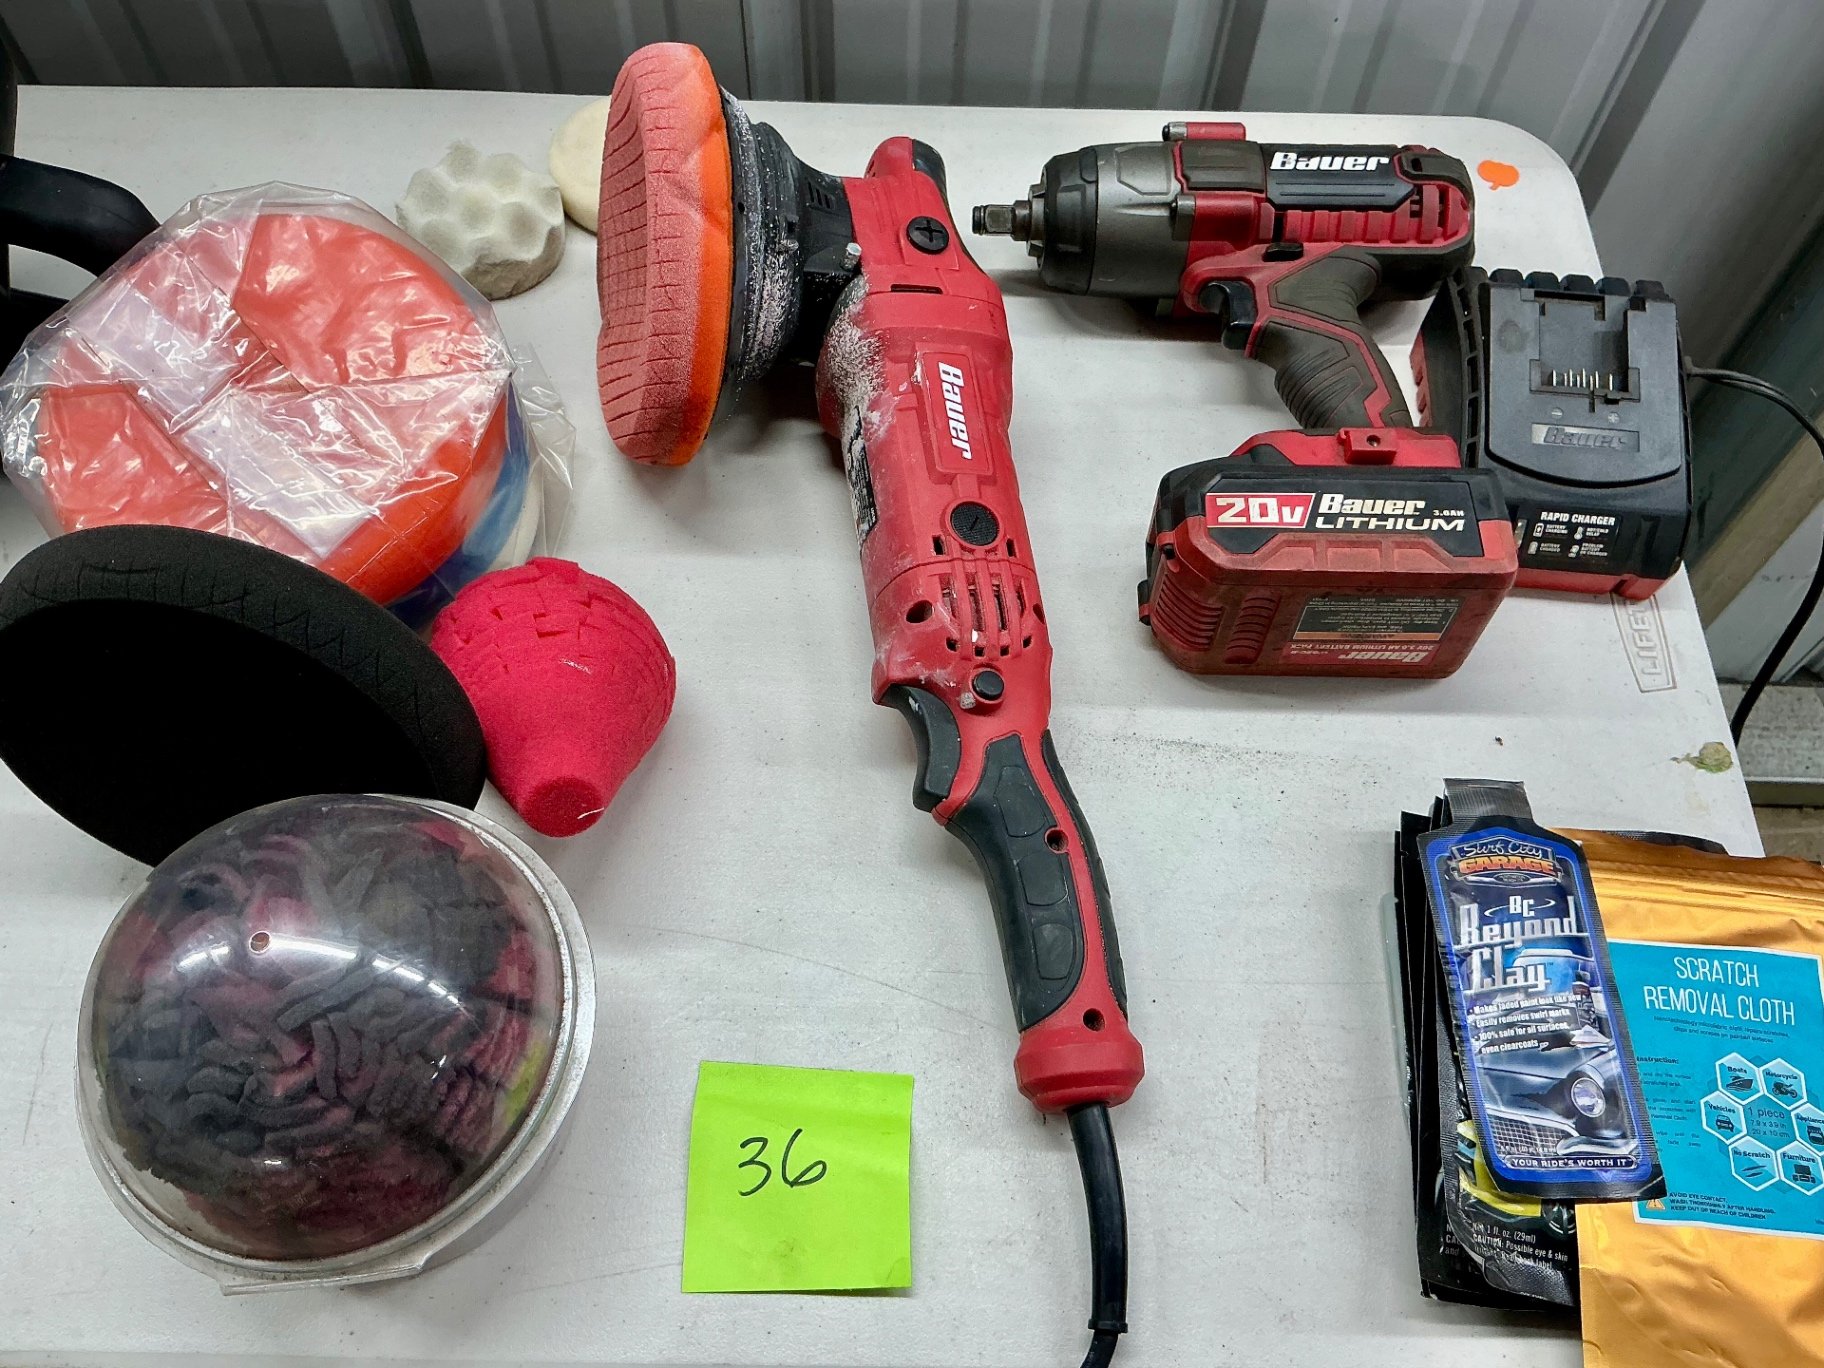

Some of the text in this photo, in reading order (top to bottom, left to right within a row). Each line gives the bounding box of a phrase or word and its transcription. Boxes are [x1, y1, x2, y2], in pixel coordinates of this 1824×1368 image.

[1270, 151, 1390, 171] Bauer
[938, 361, 972, 460] Bauer
[1542, 426, 1628, 449] Bauer
[1318, 493, 1427, 516] Bauer
[1315, 516, 1466, 532] LITHIUM
[1540, 511, 1616, 526] RAPID CHARGER
[1337, 650, 1430, 664] Bauer
[1463, 841, 1543, 858] Surf City
[1458, 855, 1557, 876] GARAGE
[1509, 895, 1536, 918] BC
[1458, 896, 1580, 949] Beyond
[1673, 956, 1760, 988] SCRATCH
[1473, 1003, 1499, 1015] Makes
[1643, 985, 1796, 1026] REMOVAL CLOTH
[1476, 1017, 1499, 1028] Easily
[1498, 1014, 1530, 1025] removes
[1530, 1011, 1549, 1021] swirl
[1478, 1030, 1499, 1041] 100%
[1498, 1029, 1516, 1038] safe
[1515, 1028, 1527, 1036] for
[1481, 1039, 1539, 1054] even clearcoats
[1727, 1066, 1748, 1074] Boats
[1765, 1071, 1799, 1081] Motorcycle
[1708, 1103, 1737, 1115] Vehicles
[1748, 1106, 1785, 1119] 1 piece
[738, 1128, 828, 1196] 36
[1512, 1158, 1627, 1168] YOUR RIDE'S WORTH IT
[1743, 1150, 1771, 1160] Scratch
[1782, 1152, 1816, 1163] Furniture
[1513, 1231, 1537, 1244] (29ml)
[1505, 1240, 1534, 1254] Possible
[1534, 1248, 1547, 1257] eye
[1547, 1249, 1553, 1259] &
